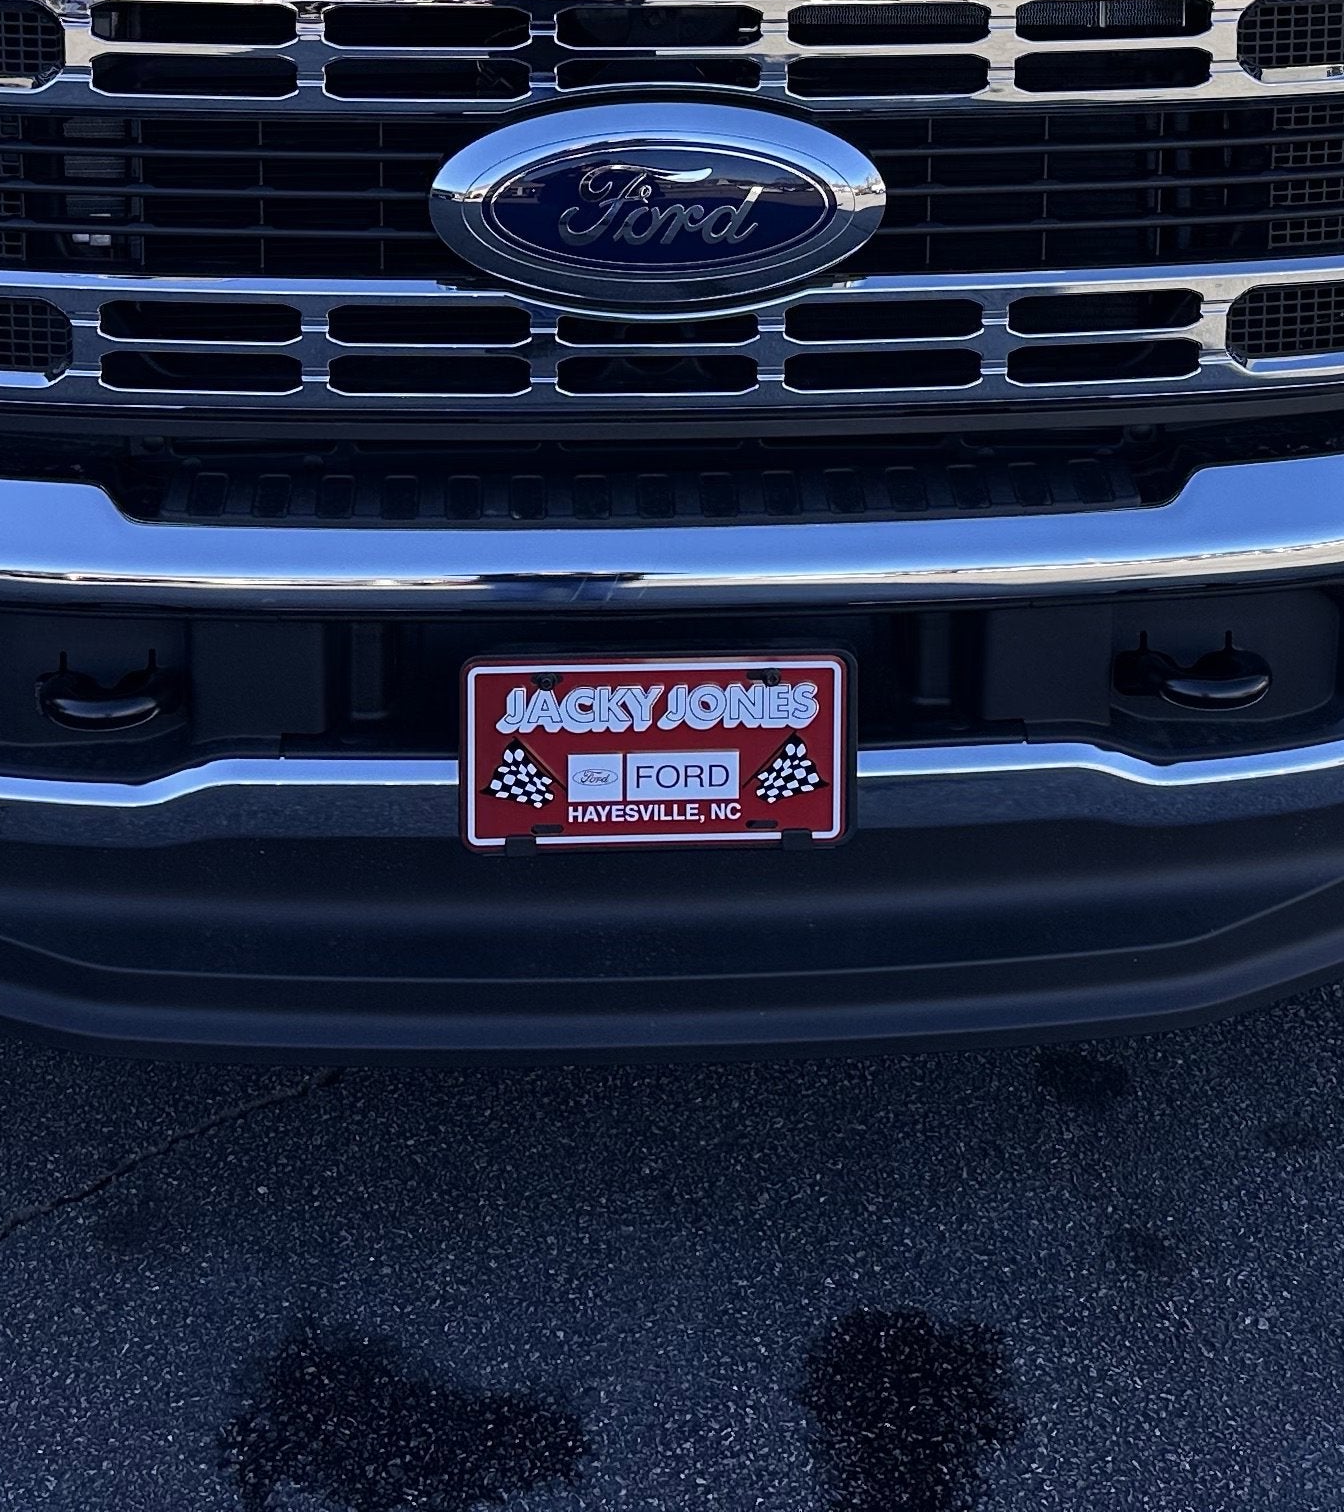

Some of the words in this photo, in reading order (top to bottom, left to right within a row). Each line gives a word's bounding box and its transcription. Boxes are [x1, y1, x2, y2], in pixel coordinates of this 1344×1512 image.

[557, 163, 764, 246] Ford
[496, 685, 664, 734] JACKY
[657, 682, 819, 731] JONES
[578, 768, 611, 786] Ford
[635, 764, 731, 790] FORD
[568, 803, 706, 823] HAYESVILLE,
[711, 802, 742, 821] NC
